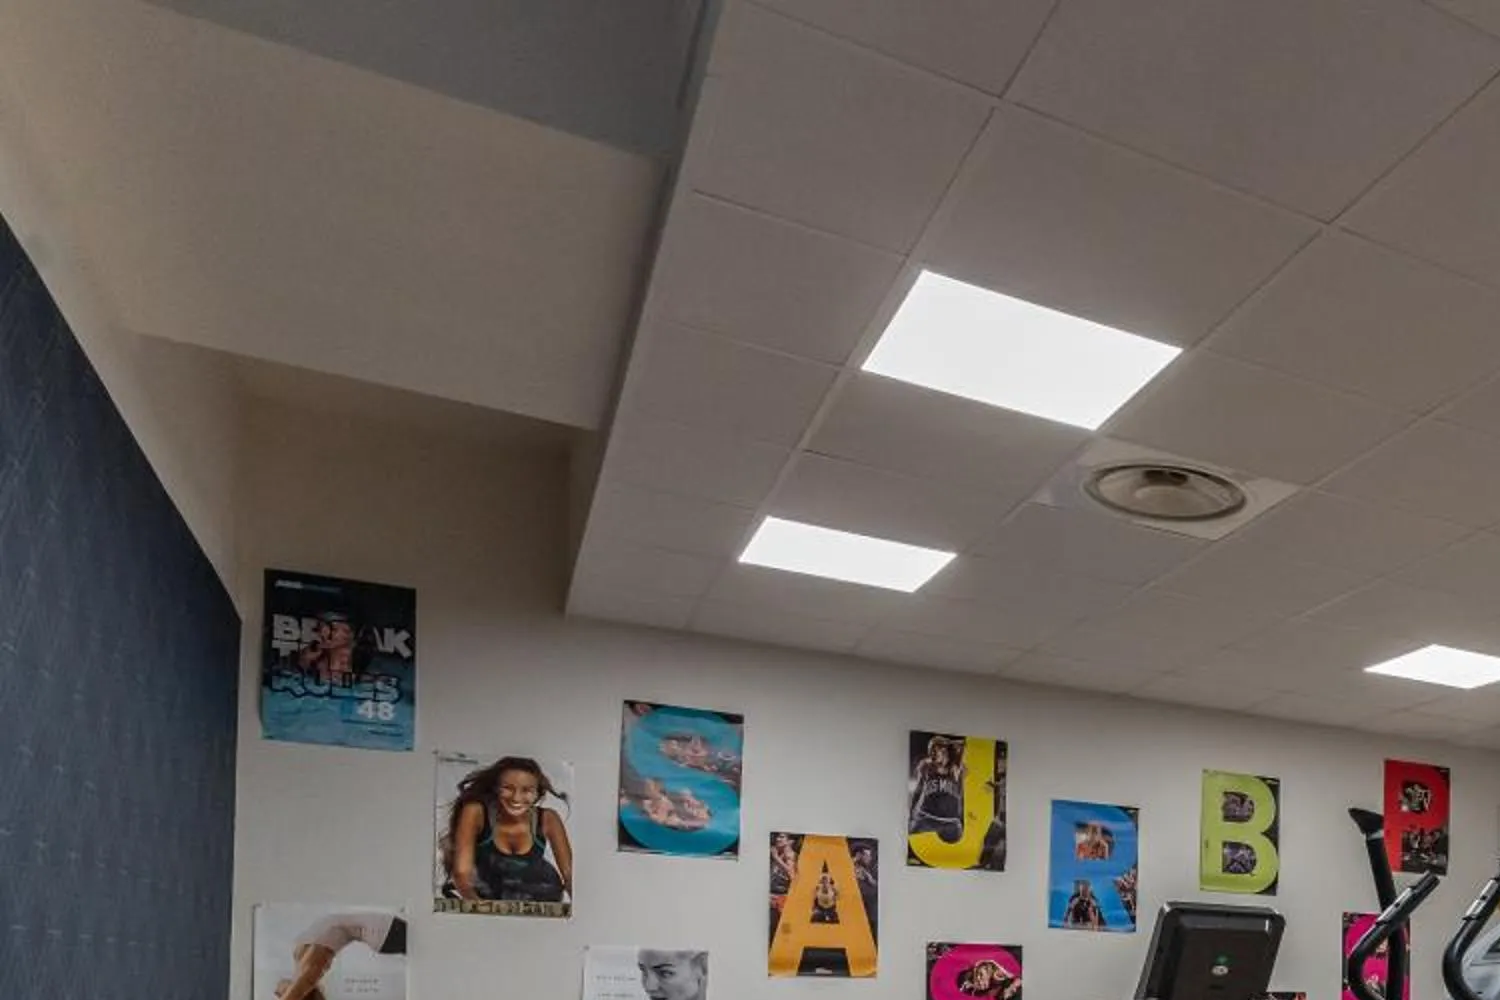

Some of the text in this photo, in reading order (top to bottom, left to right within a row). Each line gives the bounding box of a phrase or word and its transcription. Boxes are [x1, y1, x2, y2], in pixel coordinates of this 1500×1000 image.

[272, 614, 413, 659] BRK
[357, 700, 396, 721] 48
[620, 703, 740, 858] S
[908, 736, 995, 869] J
[1200, 770, 1278, 894] B
[1384, 760, 1449, 874] P
[768, 834, 878, 977] A
[1048, 800, 1138, 931] R
